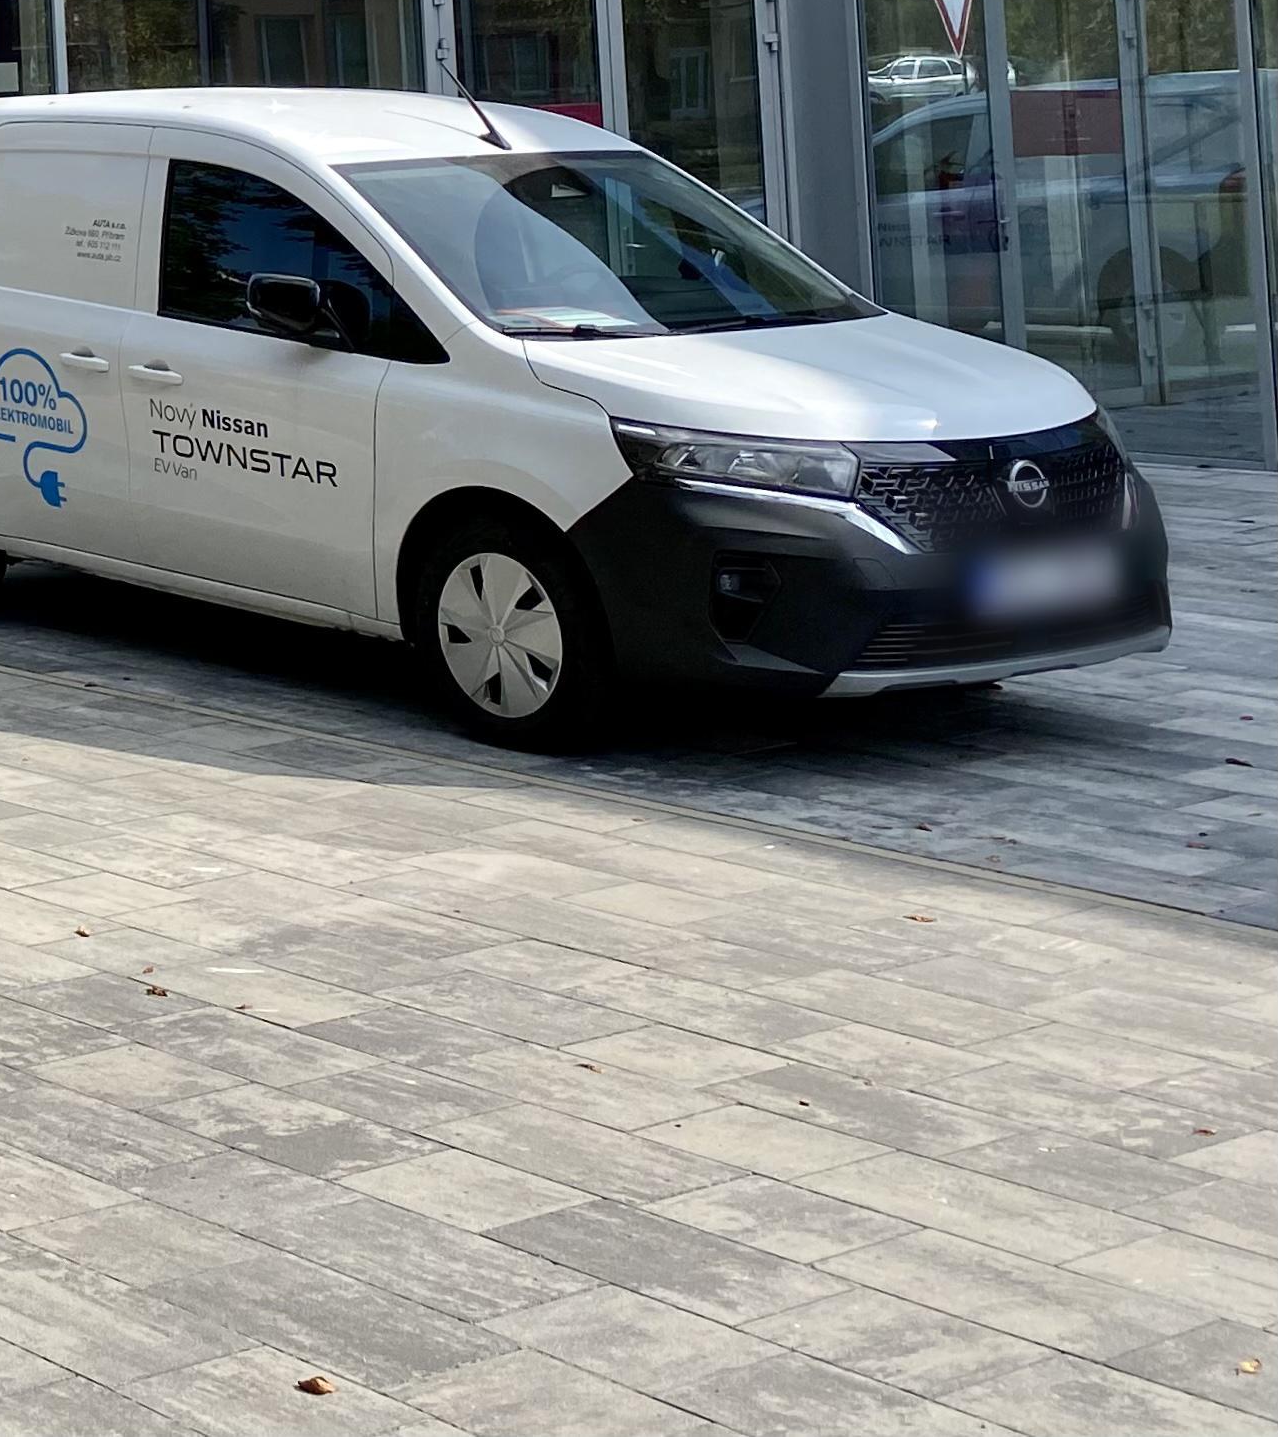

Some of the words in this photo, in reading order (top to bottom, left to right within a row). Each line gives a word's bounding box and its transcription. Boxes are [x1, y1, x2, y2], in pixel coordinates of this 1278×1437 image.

[0, 376, 57, 411] 100%
[149, 398, 197, 430] Nový
[201, 408, 269, 439] Nissan
[151, 429, 338, 488] TOWNSTAR
